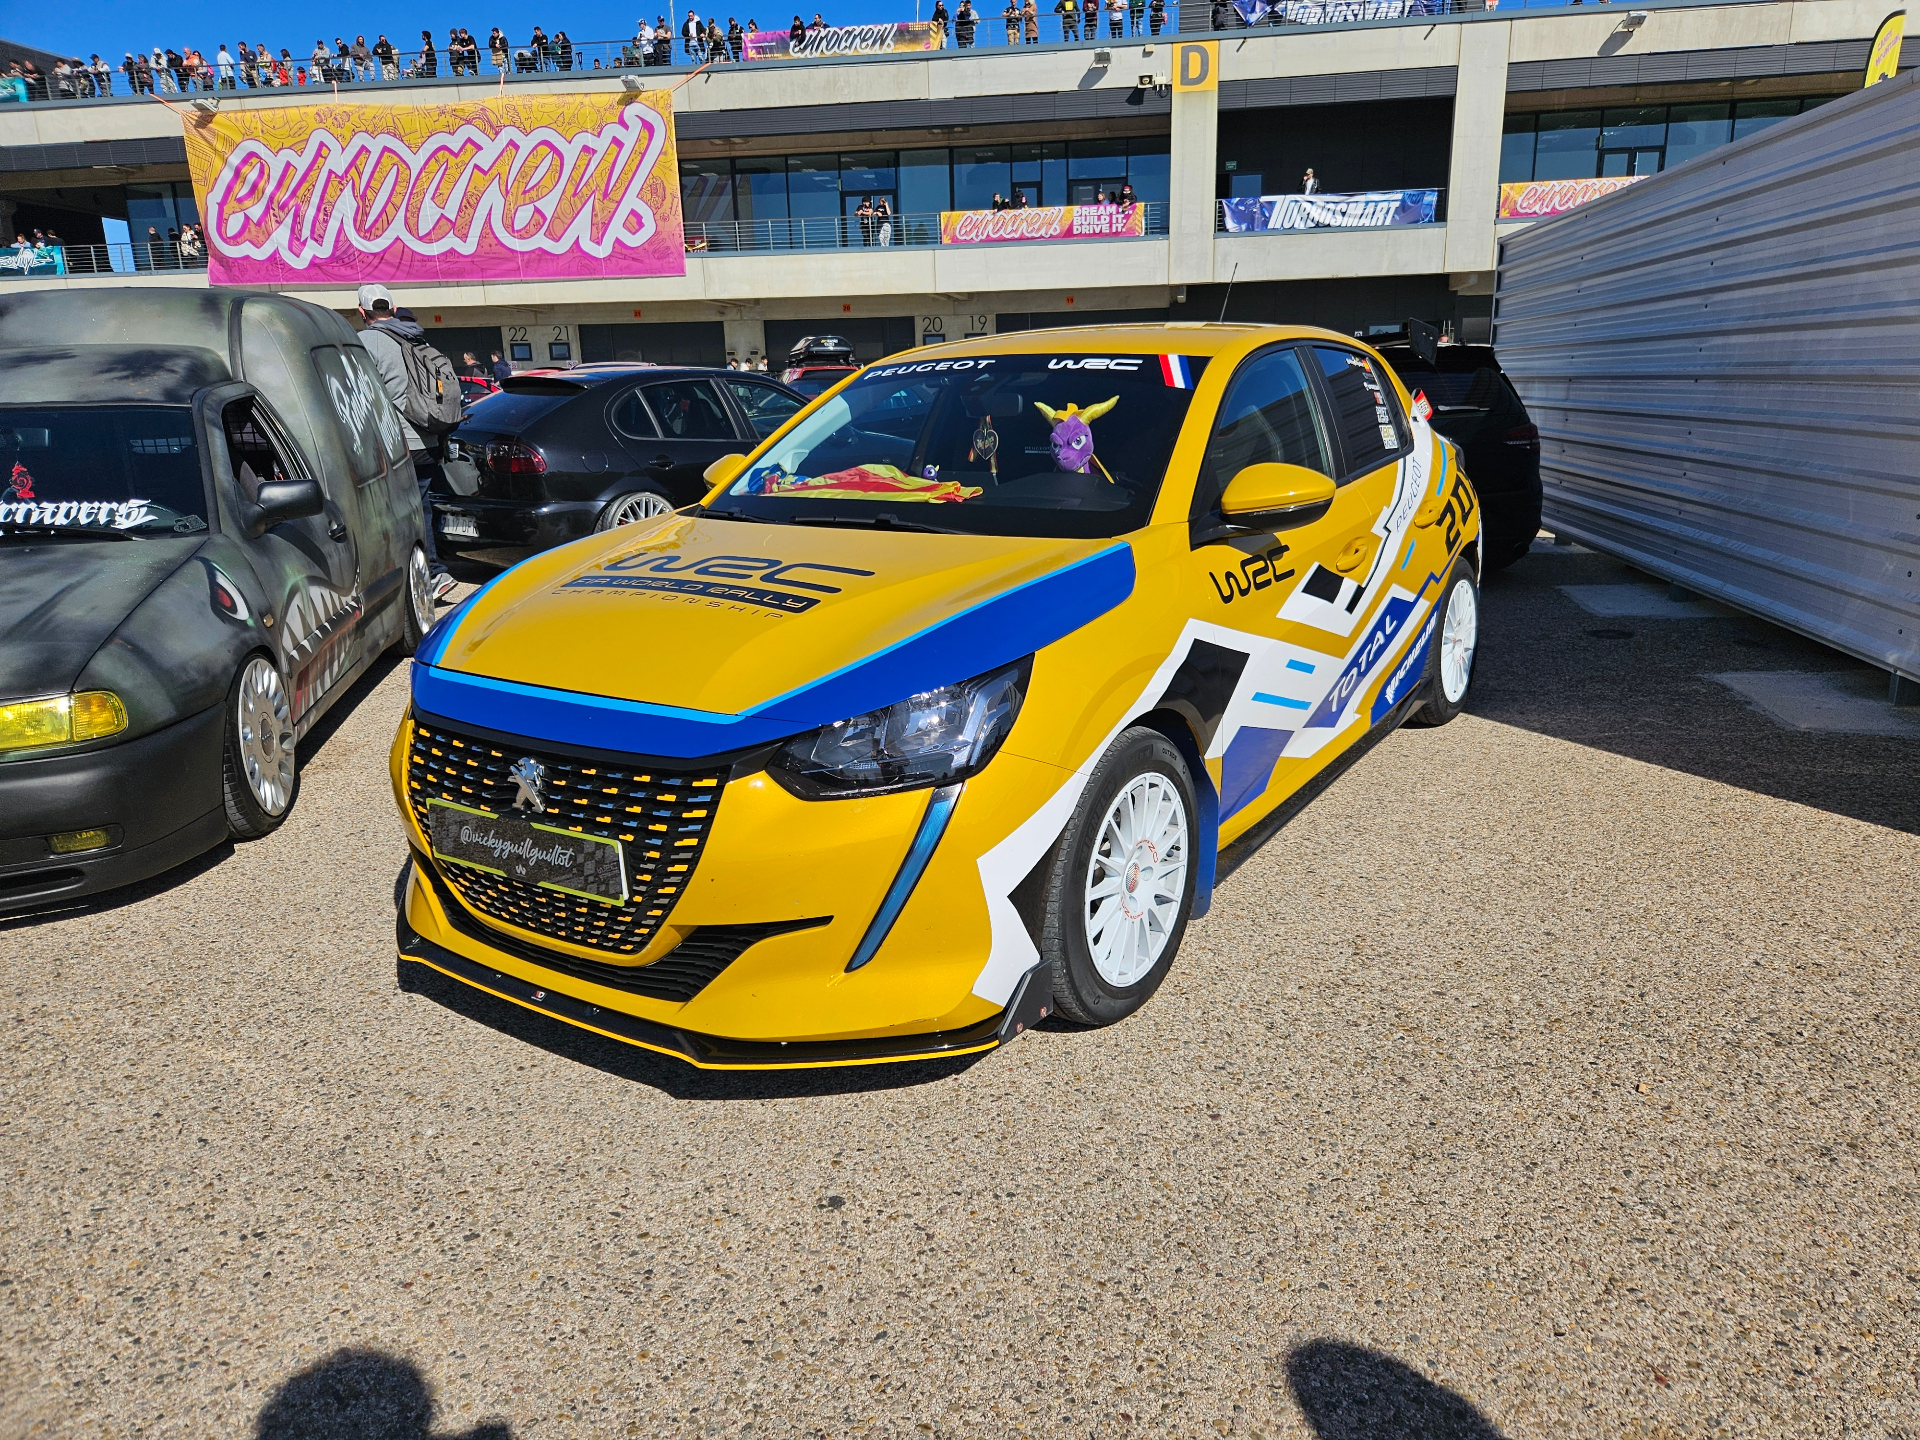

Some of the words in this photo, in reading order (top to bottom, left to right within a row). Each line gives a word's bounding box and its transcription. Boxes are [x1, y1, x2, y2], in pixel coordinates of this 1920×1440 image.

[1180, 44, 1210, 87] D
[1073, 206, 1116, 216] DREAM
[1073, 215, 1109, 226] BUILD
[1112, 214, 1126, 223] IT.
[1267, 194, 1402, 230] TURBOSMART
[1073, 224, 1109, 234] DRIVE
[1112, 223, 1125, 232] IT.
[508, 327, 529, 342] 22
[552, 326, 570, 341] 21
[922, 317, 943, 332] 20
[970, 316, 988, 331] 19
[863, 359, 996, 380] PEUGEOT
[1047, 358, 1143, 371] WRC
[1396, 456, 1422, 533] PEUGEOT
[603, 552, 876, 594] WRC
[1208, 544, 1296, 605] WRC
[550, 588, 783, 619] CHAMPIONSHIP
[612, 578, 704, 591] WORLD
[705, 586, 808, 609] RALLY
[1328, 614, 1398, 713] TOTAL
[1384, 610, 1438, 705] MICHELIN
